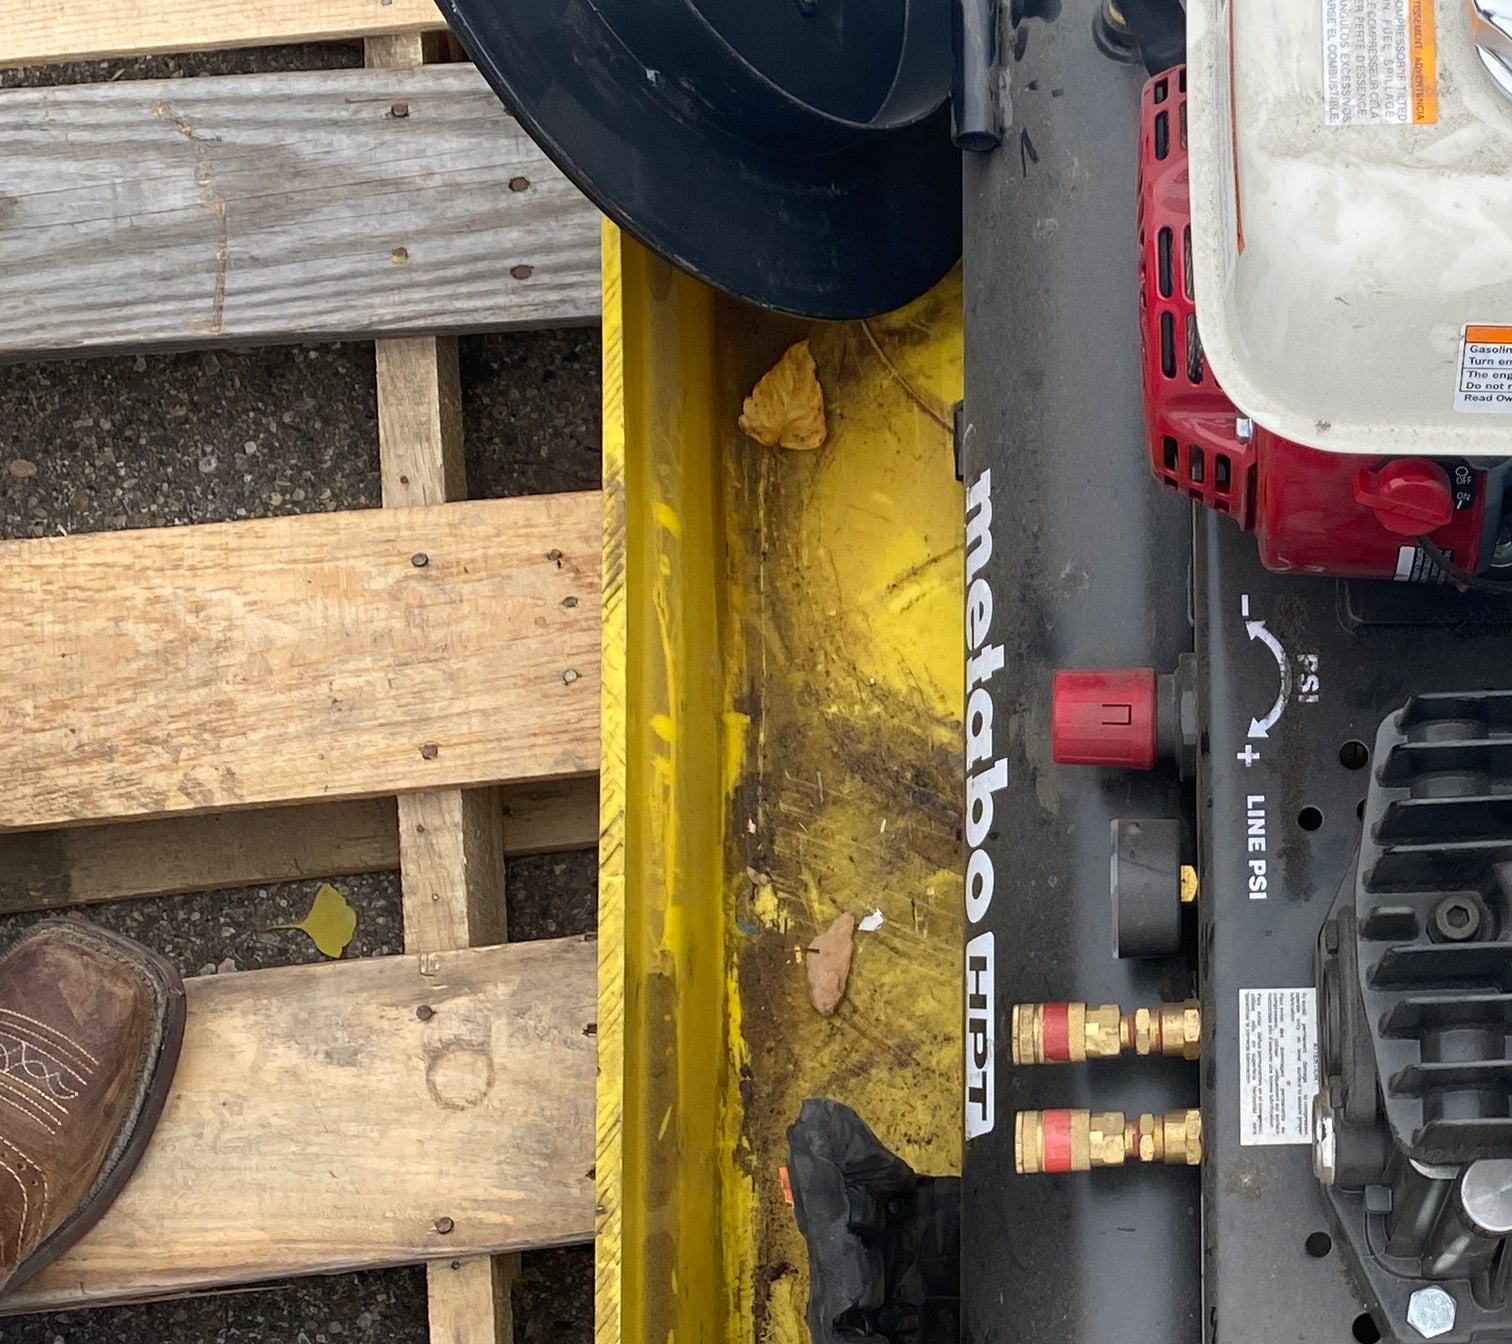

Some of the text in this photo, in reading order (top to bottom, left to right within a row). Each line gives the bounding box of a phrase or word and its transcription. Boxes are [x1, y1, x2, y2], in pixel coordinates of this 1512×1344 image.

[1327, 28, 1336, 40] EL
[1354, 16, 1364, 49] PERTE
[1382, 19, 1392, 49] FUEL
[1367, 11, 1378, 89] COMPRESSEUR
[1340, 53, 1351, 122] EXCESSIVOS
[1396, 70, 1405, 81] IF
[1414, 56, 1425, 120] ADVERTENCIA
[1396, 86, 1407, 121] TILTED
[1466, 370, 1488, 379] The
[1467, 357, 1495, 366] Turn
[1463, 394, 1493, 402] Read
[1465, 381, 1481, 390] Do
[1484, 382, 1504, 391] not
[1456, 476, 1472, 485] OFF
[1456, 491, 1471, 502] ON
[1298, 654, 1320, 703] PSI
[966, 468, 1008, 1122] metabo HPT
[1247, 795, 1267, 900] LINE PSI
